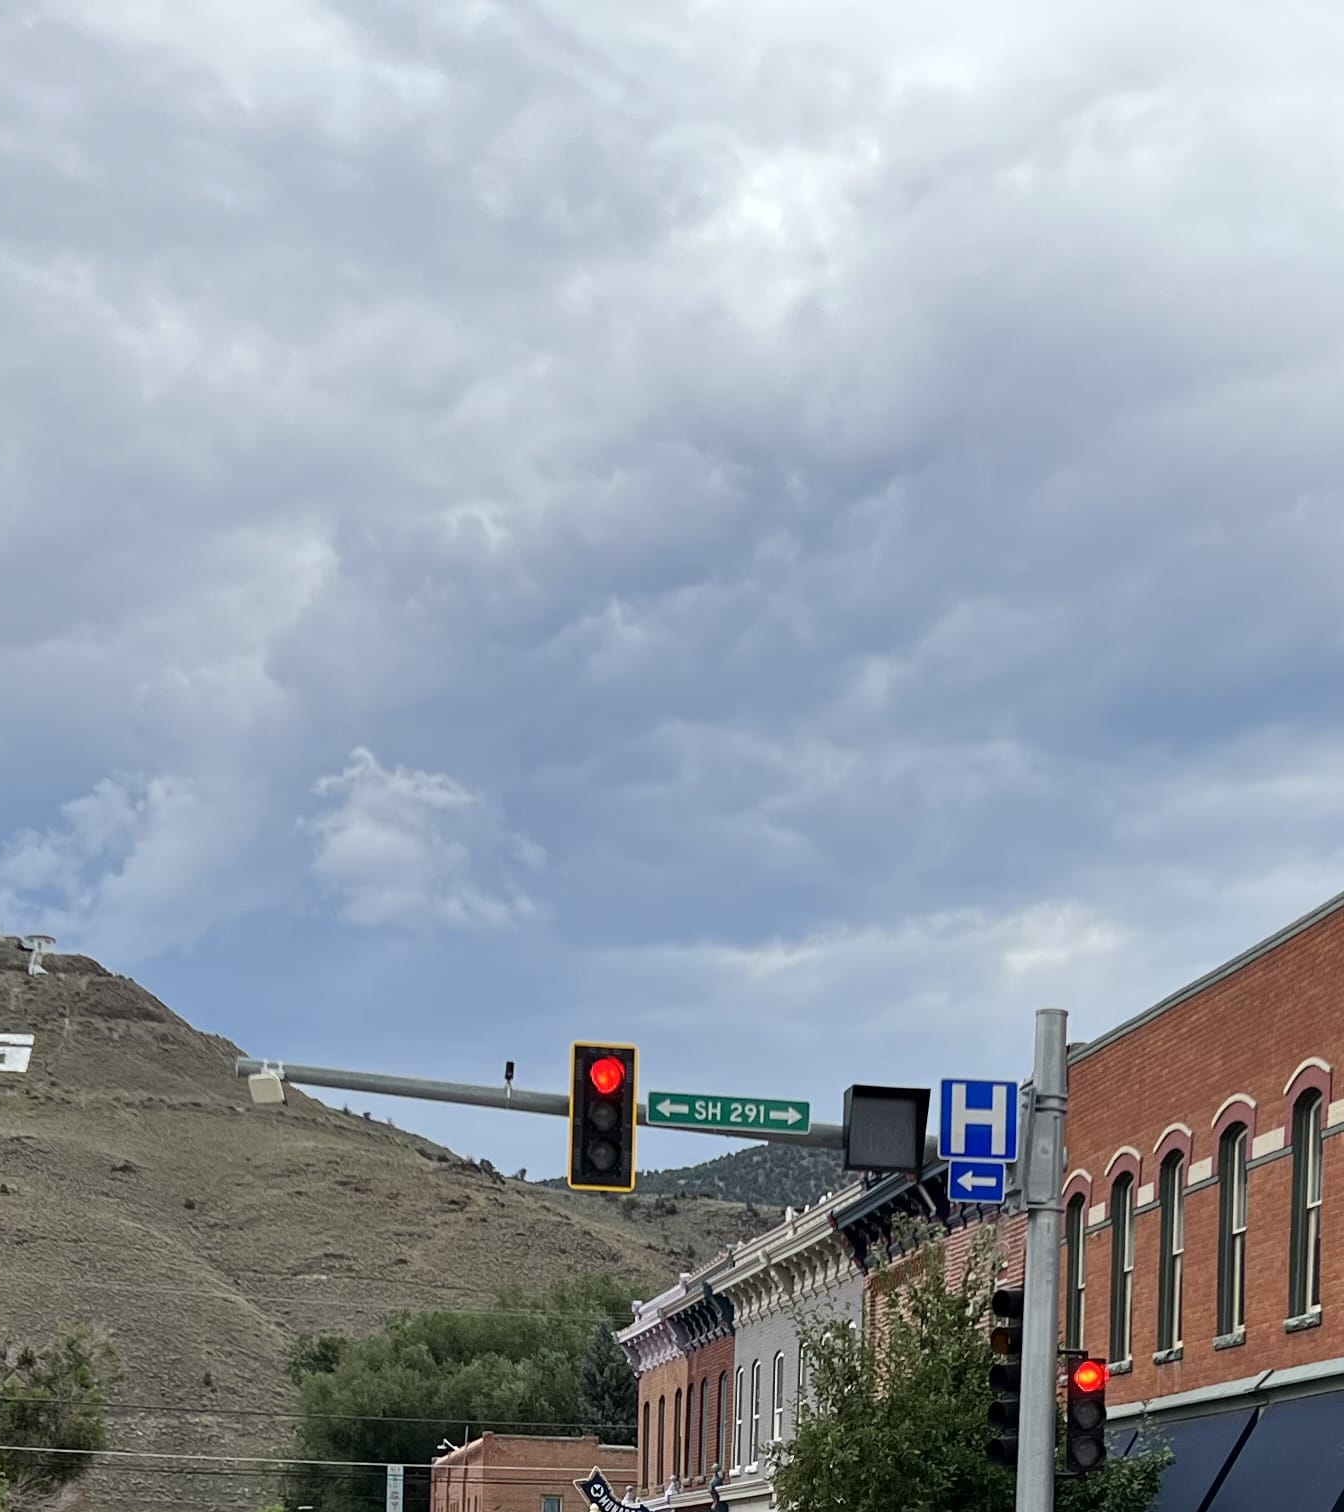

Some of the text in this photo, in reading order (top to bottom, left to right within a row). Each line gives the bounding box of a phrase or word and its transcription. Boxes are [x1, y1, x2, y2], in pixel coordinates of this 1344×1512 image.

[694, 1100, 765, 1124] SH 291
[950, 1082, 1008, 1156] H
